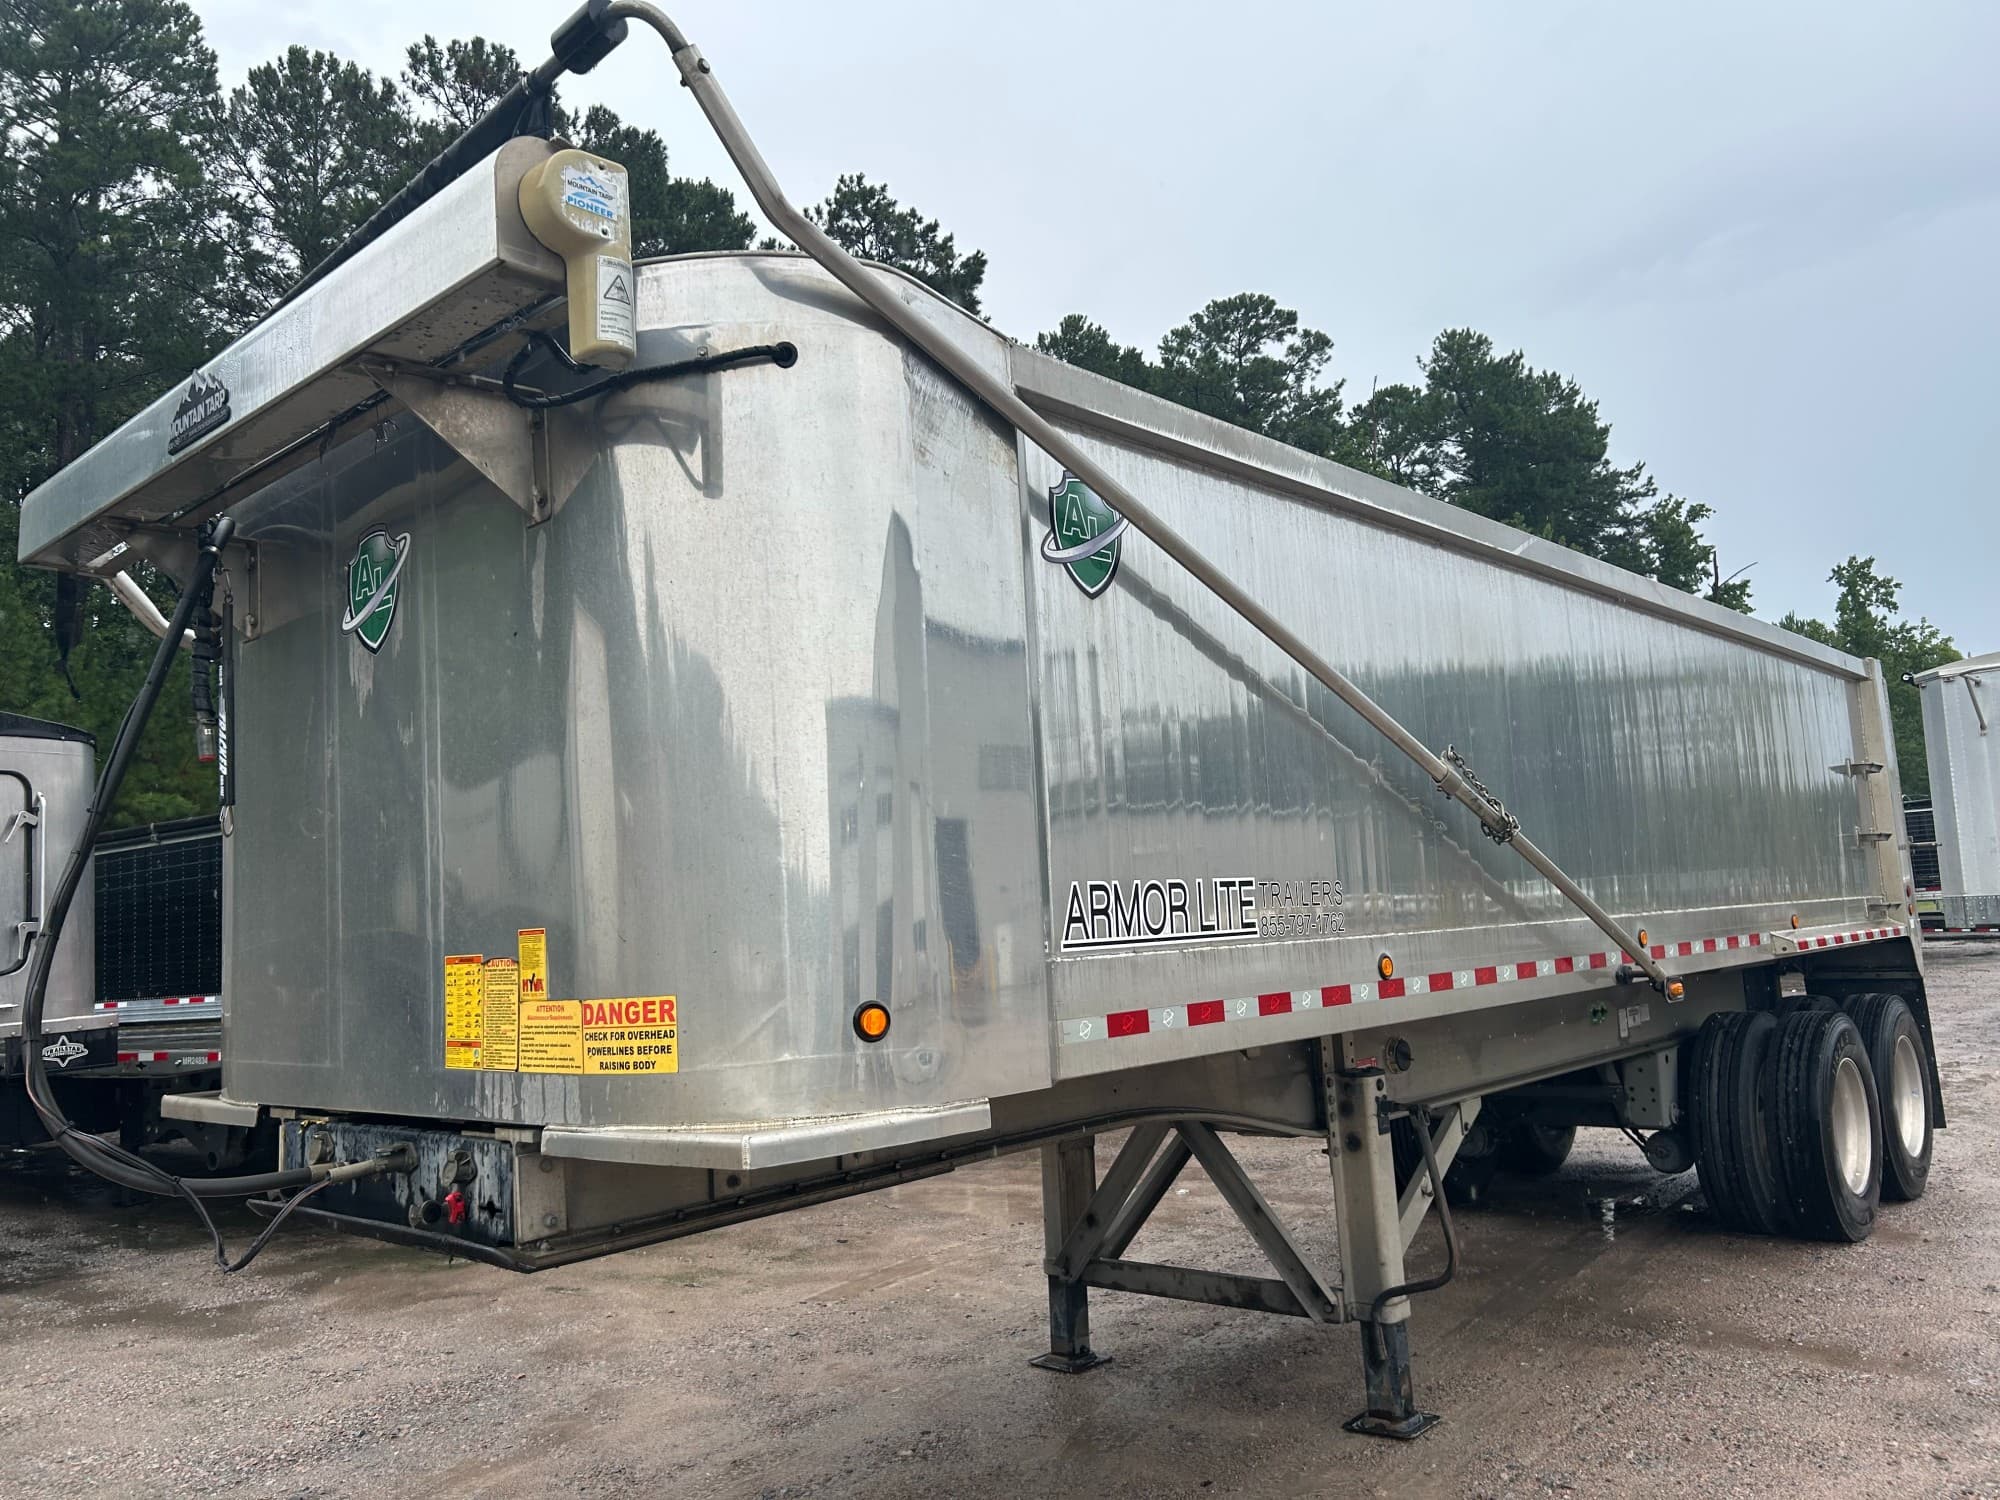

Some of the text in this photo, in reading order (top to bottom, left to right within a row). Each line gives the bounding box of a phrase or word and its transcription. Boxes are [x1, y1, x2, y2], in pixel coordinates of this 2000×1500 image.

[567, 178, 614, 201] MOUNTAIN TARP
[566, 194, 614, 219] PIONEER
[168, 401, 206, 438] MOUNTAIN
[205, 388, 226, 414] TARP
[1064, 876, 1344, 941] ARMOR LITE TRAILERS
[1260, 911, 1346, 938] 855-797-1762
[536, 1004, 565, 1013] ATTENTION
[583, 999, 676, 1026] DANGER
[584, 1029, 675, 1041] CHECK FOR OVERHEAD
[587, 1044, 673, 1057] POWERLINES BEFORE
[599, 1059, 657, 1071] RAISING BODY
